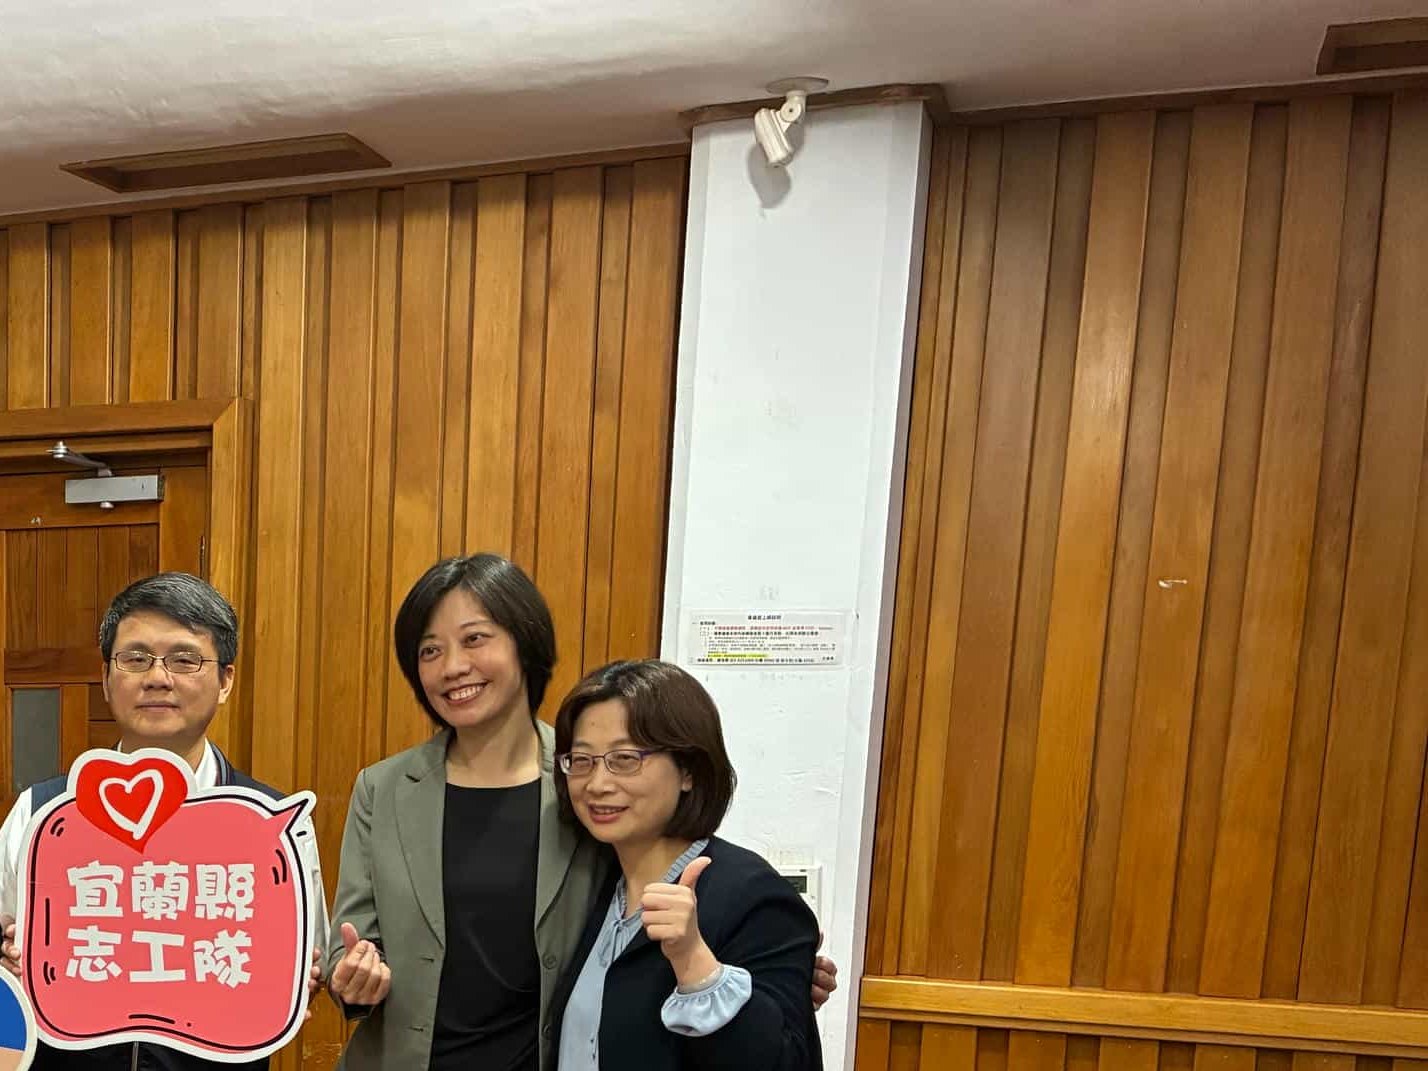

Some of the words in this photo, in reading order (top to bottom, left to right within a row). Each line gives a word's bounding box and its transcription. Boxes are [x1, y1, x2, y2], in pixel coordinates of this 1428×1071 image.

[66, 860, 254, 922] 宜蘭縣
[65, 924, 252, 988] 志工隊
